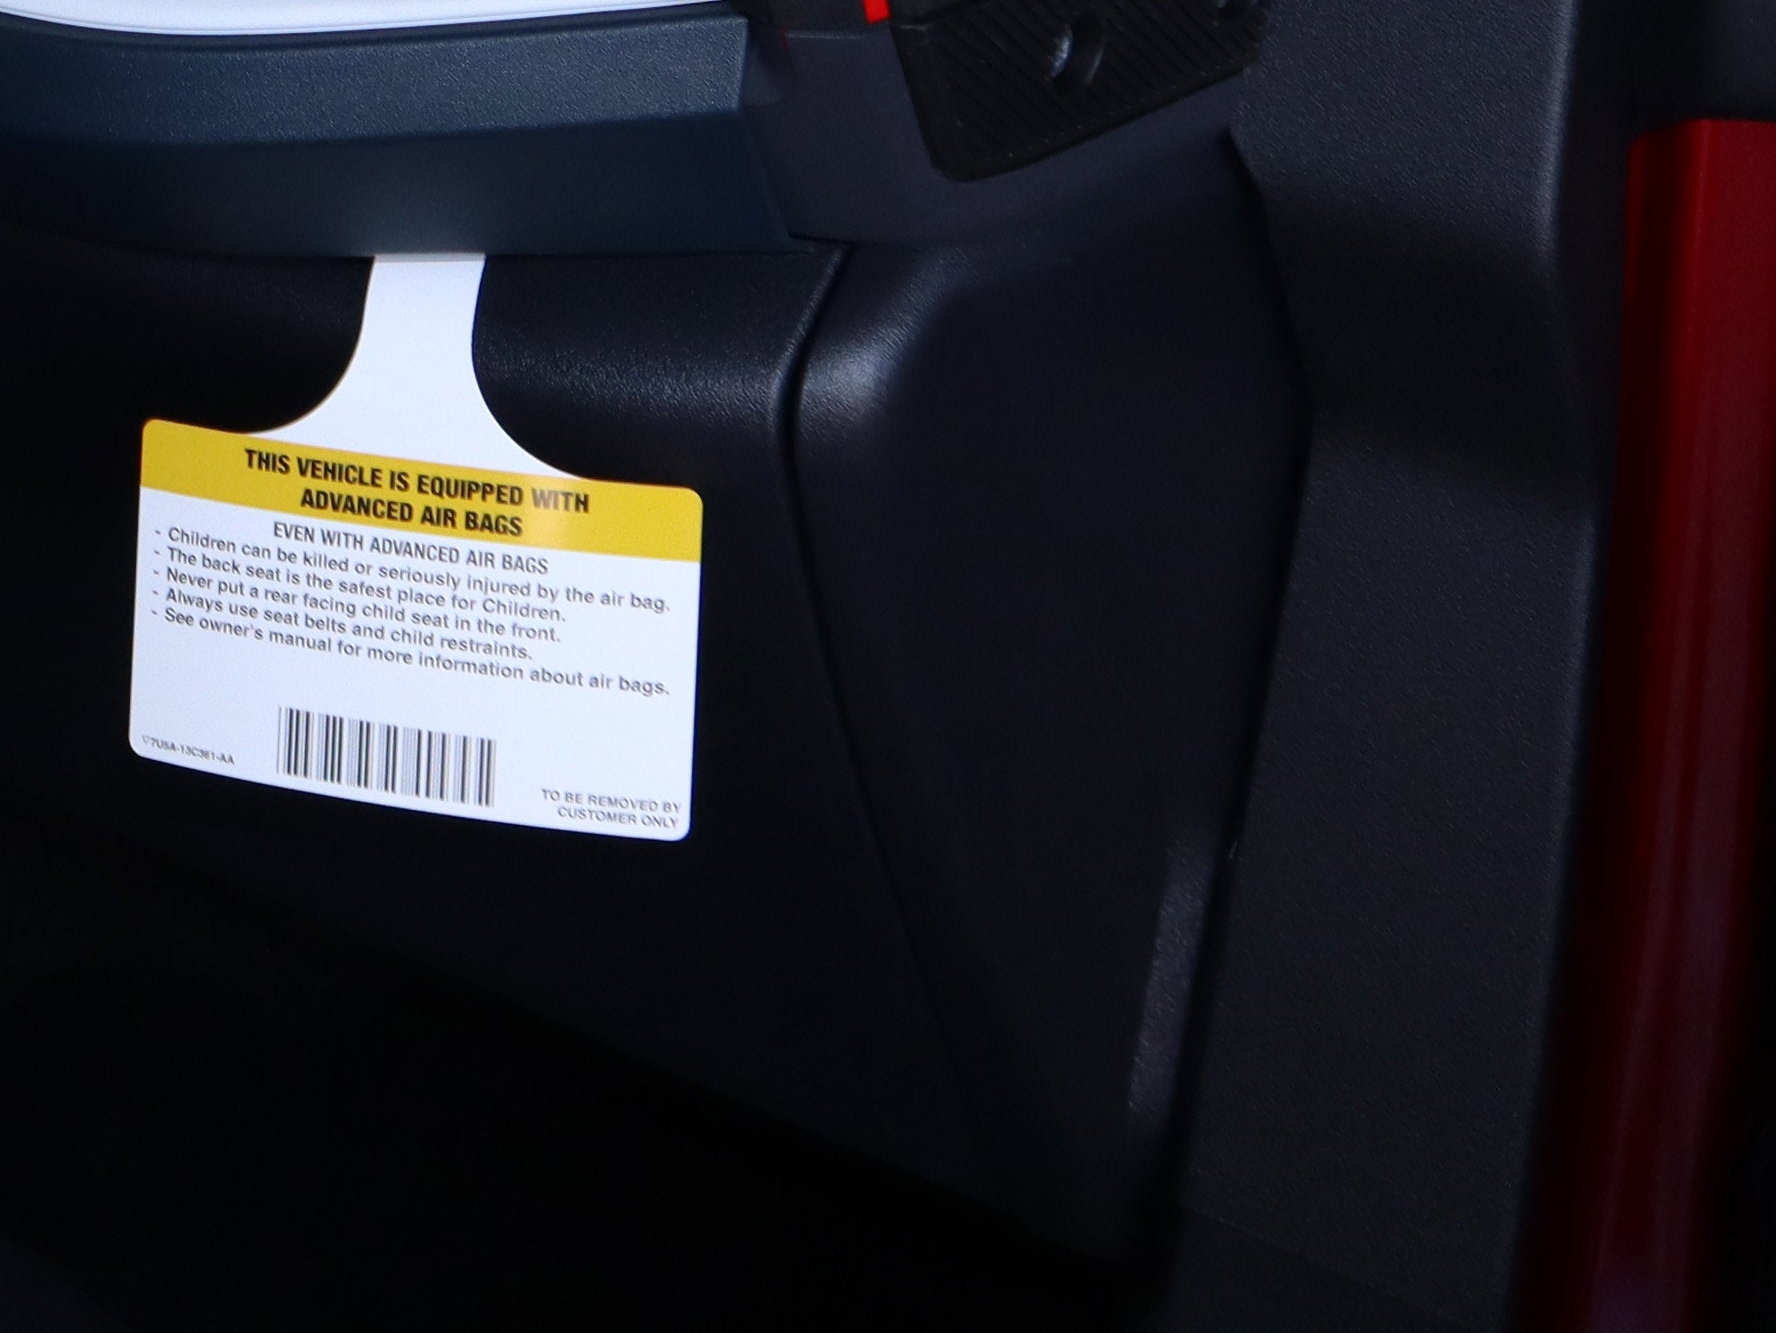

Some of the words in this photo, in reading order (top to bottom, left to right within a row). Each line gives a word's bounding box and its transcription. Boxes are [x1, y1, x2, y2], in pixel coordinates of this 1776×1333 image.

[245, 449, 290, 475] THIS
[296, 456, 383, 488] VEHICLE
[390, 470, 410, 492] IS
[417, 474, 524, 506] EQUIPPED
[532, 487, 590, 513] WITH
[301, 488, 413, 523] ADVANCED
[421, 506, 457, 530] AIR
[465, 511, 523, 537] BAGS
[168, 526, 236, 554] Children
[242, 543, 272, 559] can
[277, 547, 298, 564] be
[303, 552, 349, 572] killed
[355, 560, 373, 575] or
[378, 566, 460, 591] seriously
[467, 574, 531, 596] injured
[537, 584, 559, 603] by
[565, 587, 595, 604] the
[600, 590, 625, 607] air
[630, 592, 670, 614] bag.
[274, 521, 315, 544] EVEN
[321, 528, 363, 551] WITH
[370, 536, 460, 564] ADVANCED
[466, 549, 495, 569] AIR
[502, 554, 549, 574] BAGS
[166, 566, 213, 590] Never
[218, 579, 245, 596] put
[250, 586, 259, 599] a
[264, 588, 298, 605] rear
[304, 594, 357, 617] facing
[362, 604, 406, 623] child
[411, 612, 450, 629] seat
[455, 614, 472, 632] in
[477, 618, 506, 636] the
[512, 622, 562, 643] front.
[167, 546, 197, 565] The
[202, 555, 241, 575] back
[247, 565, 281, 582] seat
[286, 569, 300, 584] is
[306, 572, 333, 590] the
[339, 579, 393, 600] safest
[398, 586, 446, 606] place
[451, 593, 476, 611] for
[483, 598, 567, 622] Children.
[164, 607, 195, 627] See
[199, 617, 263, 641] owner's
[269, 630, 332, 653] manual
[338, 639, 363, 657] for
[367, 645, 413, 664] more
[418, 651, 524, 680] information
[530, 667, 584, 687] about
[589, 673, 614, 689] air
[619, 674, 670, 697] bags.
[166, 588, 223, 613] Always
[229, 604, 259, 619] use
[263, 610, 300, 627] seat
[305, 614, 347, 634] belts
[352, 623, 385, 641] and
[391, 627, 435, 648] child
[440, 637, 533, 661] restraints.
[541, 788, 560, 801] TO
[565, 791, 583, 804] BE
[588, 794, 658, 812] REMOVED
[662, 801, 681, 813] BY
[557, 806, 637, 824] CUSTOMER
[641, 815, 679, 828] ONLY
